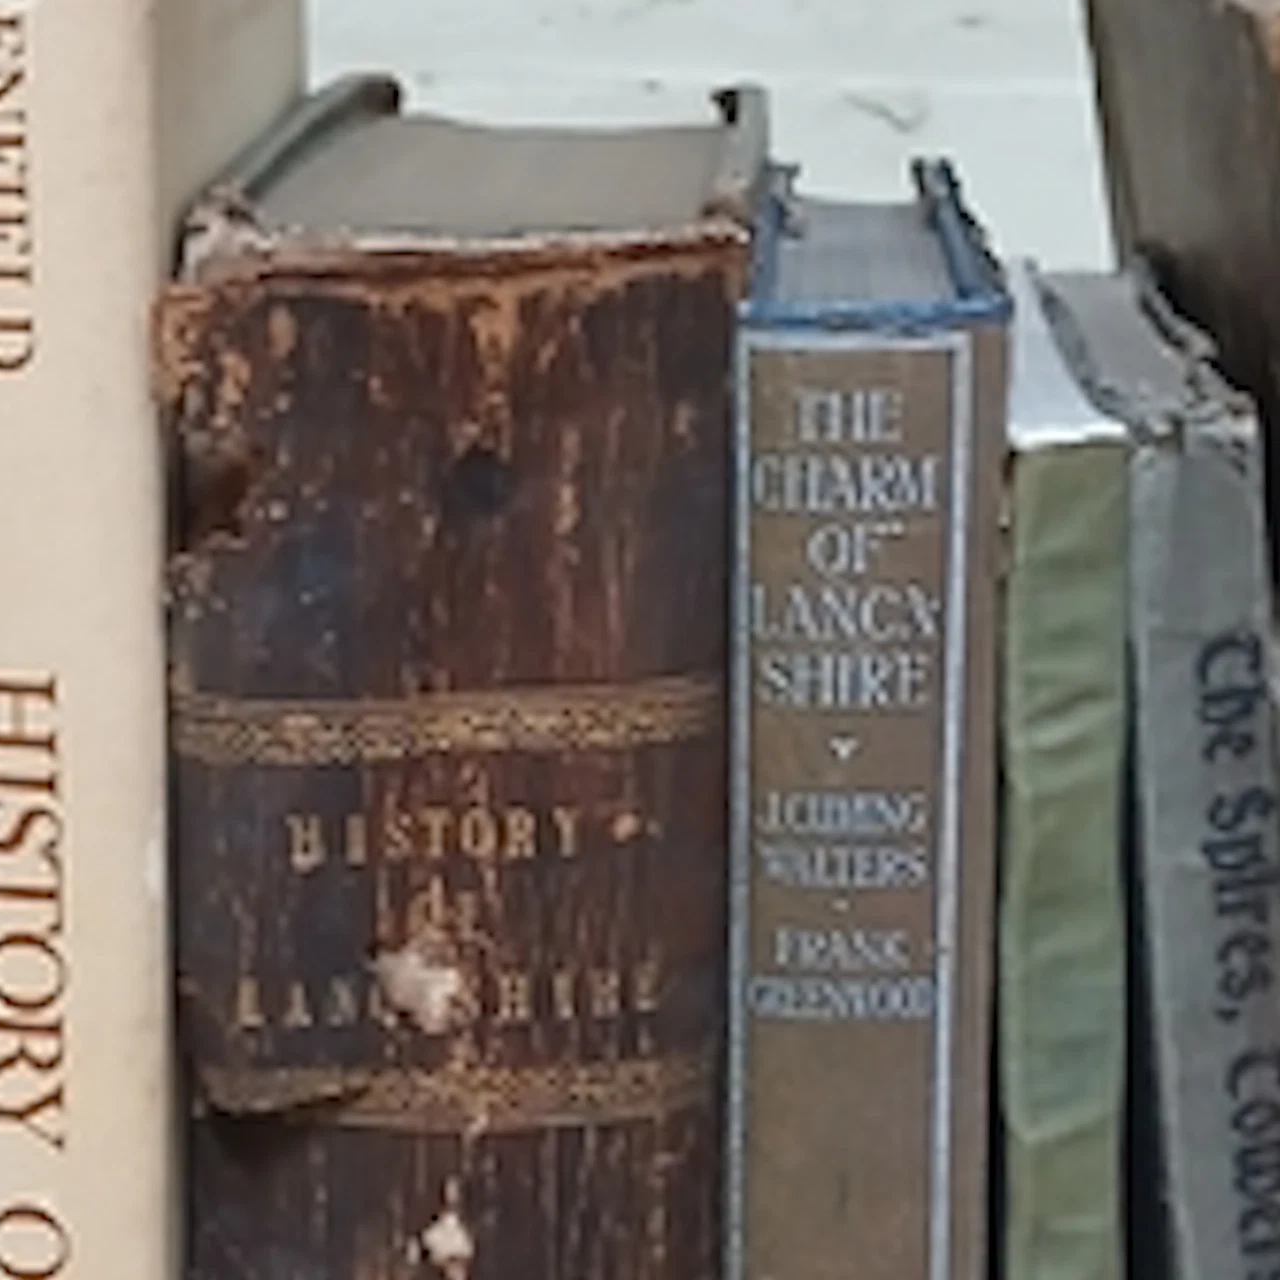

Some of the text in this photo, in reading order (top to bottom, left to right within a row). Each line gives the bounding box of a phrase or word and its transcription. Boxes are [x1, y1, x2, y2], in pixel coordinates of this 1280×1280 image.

[796, 388, 903, 443] THE
[750, 453, 942, 511] CHARM
[806, 521, 905, 575] OF
[757, 651, 929, 707] SHIRE
[1196, 629, 1267, 763] The
